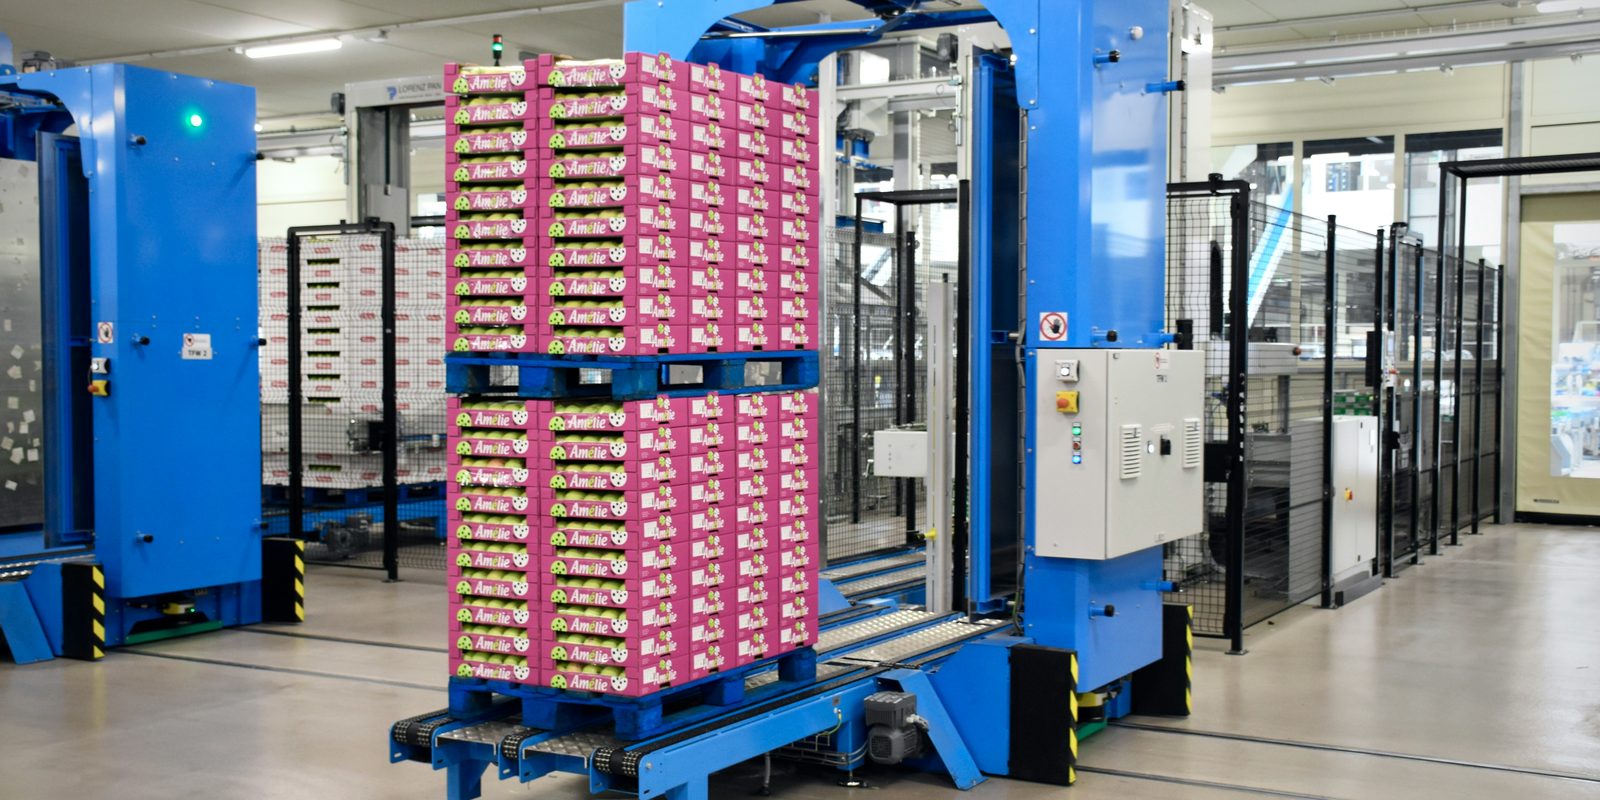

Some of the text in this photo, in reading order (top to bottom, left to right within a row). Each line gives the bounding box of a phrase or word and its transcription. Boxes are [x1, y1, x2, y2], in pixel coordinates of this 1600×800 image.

[475, 413, 509, 426] Amélie
[569, 416, 605, 429] Amélie
[475, 441, 509, 454] Amélie
[570, 445, 607, 459] Amélie
[570, 474, 607, 488] Amélie
[475, 497, 509, 511] Amélie
[570, 503, 607, 517] Amélie
[475, 525, 510, 539] Amélie
[570, 531, 607, 546] Amélie
[475, 554, 510, 567] Amélie
[570, 561, 607, 575] Amélie
[475, 581, 509, 596] Amélie
[571, 590, 608, 604] Amélie
[475, 609, 510, 624] Amélie
[571, 618, 608, 632] Amélie
[476, 636, 510, 651] Amélie
[571, 647, 608, 661] Amélie
[476, 664, 510, 679] Amélie
[570, 675, 607, 691] Amélie
